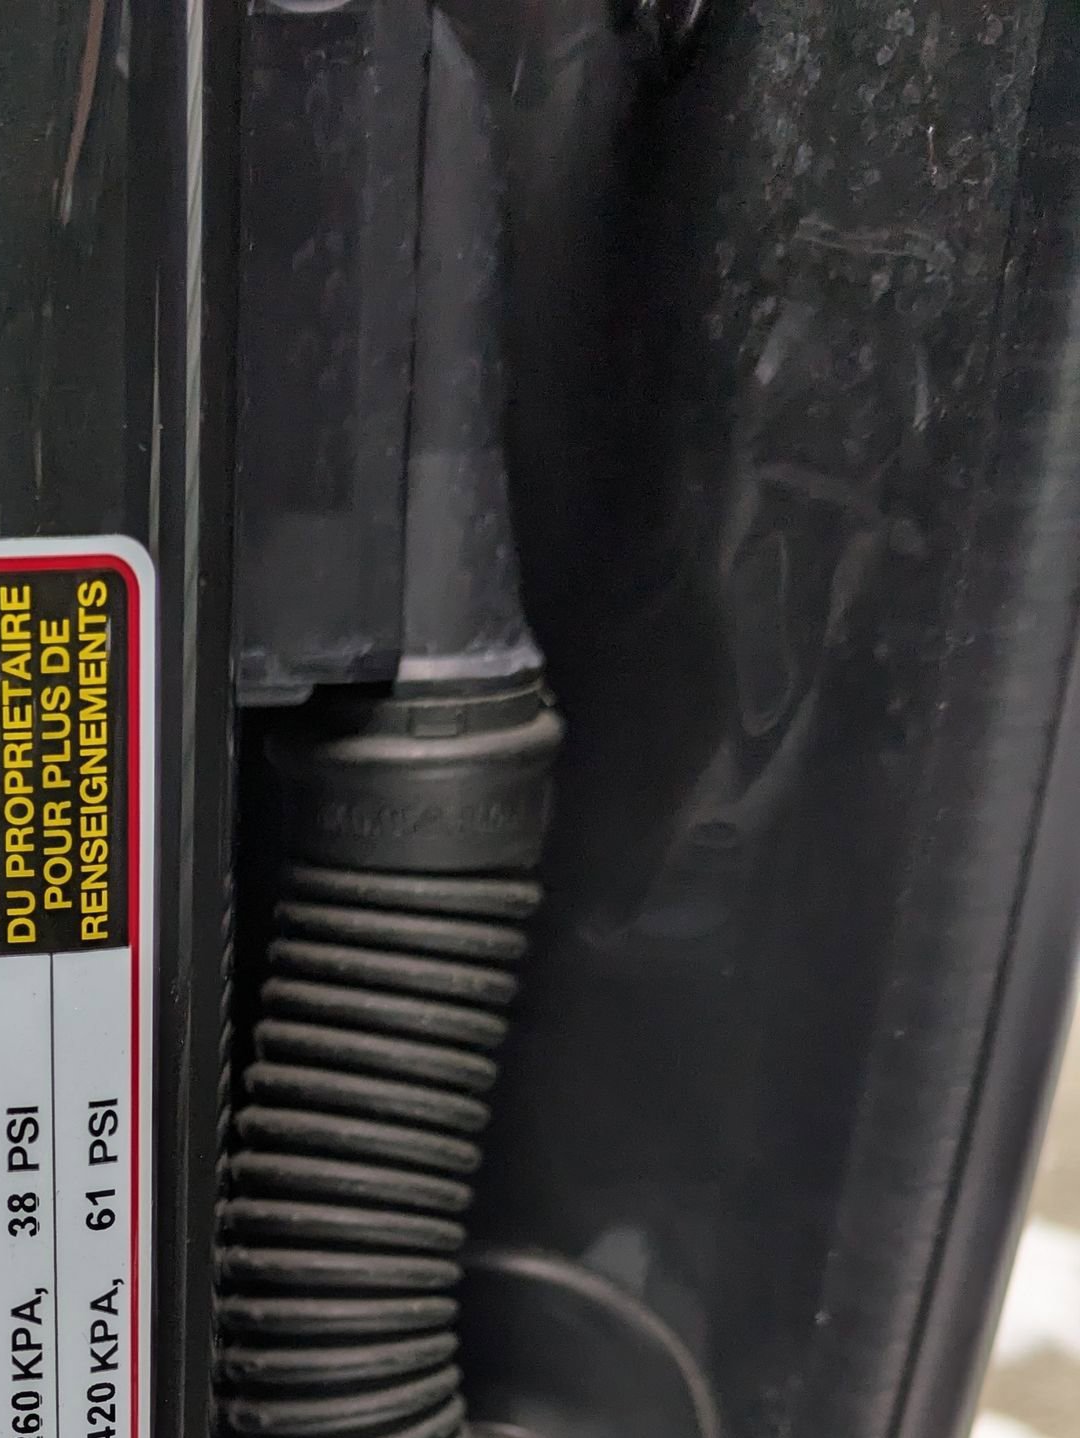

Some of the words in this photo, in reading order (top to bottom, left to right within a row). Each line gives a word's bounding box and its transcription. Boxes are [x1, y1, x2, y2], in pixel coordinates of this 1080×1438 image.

[40, 619, 70, 673] DE
[0, 586, 34, 877] PROPRIETAIRE
[41, 686, 71, 788] PLUS
[77, 581, 109, 940] RENSEIGNEMENTS
[43, 801, 72, 909] POUR
[7, 891, 36, 943] DU
[7, 1106, 39, 1172] PSI
[88, 1099, 118, 1165] PSI
[8, 1192, 40, 1237] 38
[86, 1189, 115, 1230] 61
[11, 1288, 48, 1381] KPA,
[90, 1279, 124, 1373] KPA,
